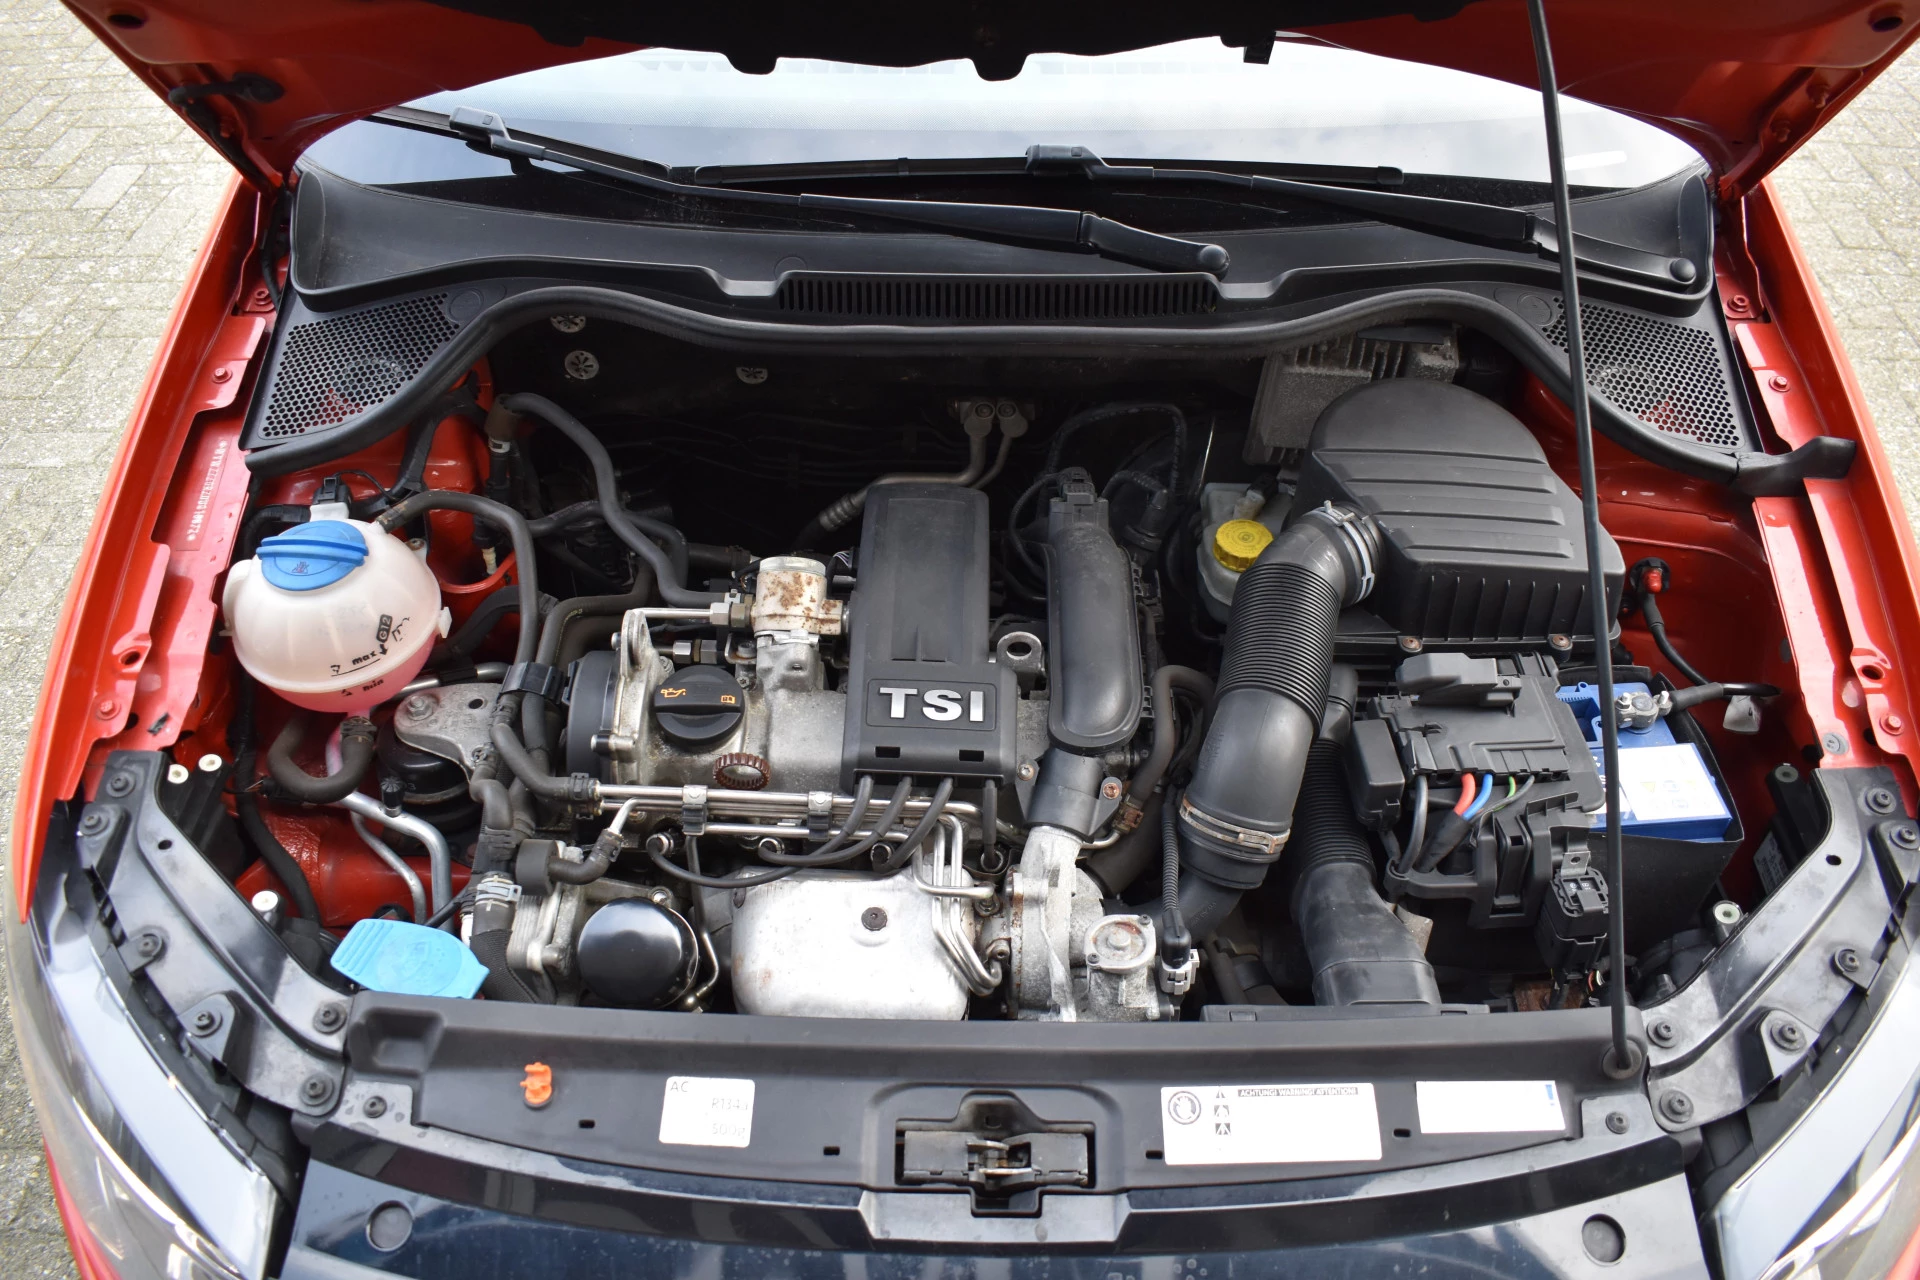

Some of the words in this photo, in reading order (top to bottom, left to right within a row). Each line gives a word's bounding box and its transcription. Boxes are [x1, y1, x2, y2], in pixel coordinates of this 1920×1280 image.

[378, 615, 391, 640] G12
[352, 650, 377, 665] max
[878, 687, 984, 722] TSI
[669, 1080, 689, 1093] AC
[1239, 1088, 1278, 1097] ACHTUNG!
